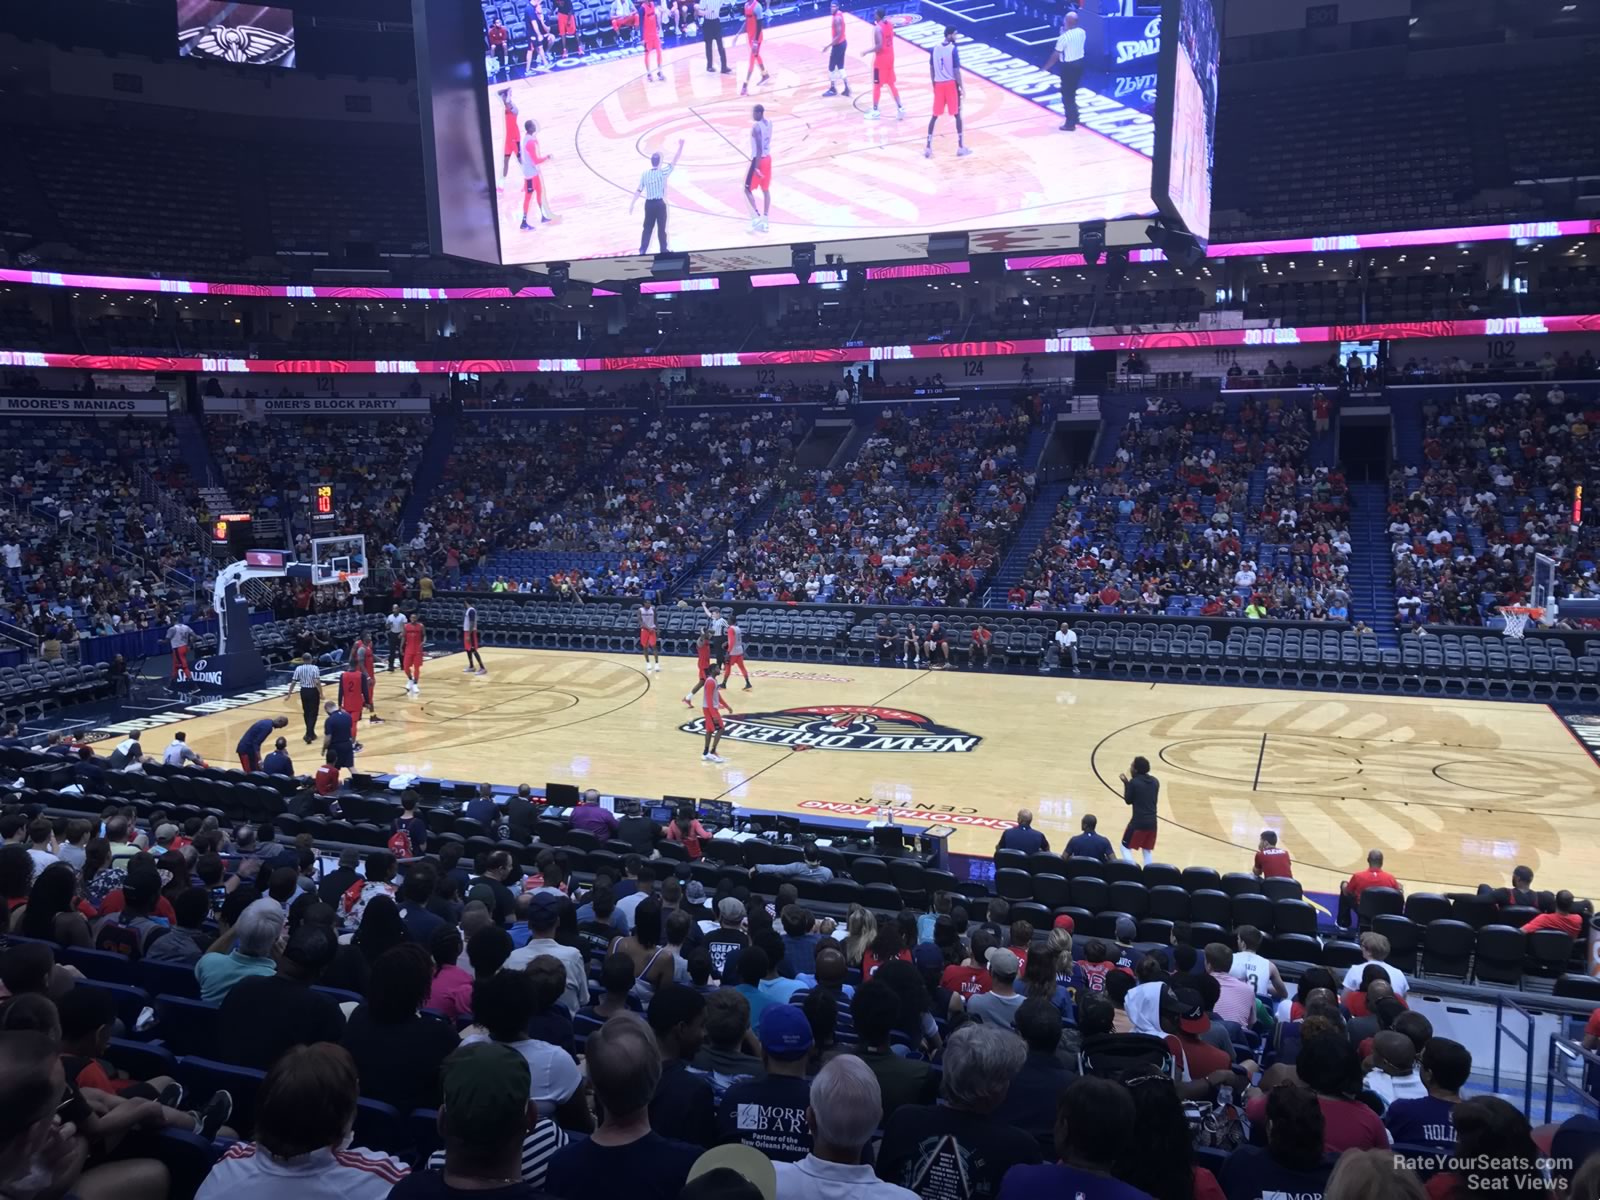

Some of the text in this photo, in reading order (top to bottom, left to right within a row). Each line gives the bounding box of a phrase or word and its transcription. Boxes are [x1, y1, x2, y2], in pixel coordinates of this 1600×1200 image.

[1510, 224, 1524, 238] DO
[963, 361, 984, 376] 124
[316, 377, 335, 391] 121
[564, 376, 584, 390] 122
[756, 370, 775, 384] 123
[8, 399, 136, 410] MOORE'S MANIACS
[265, 400, 397, 409] OMER'S BLOCK PARTY
[319, 496, 331, 512] 10
[861, 736, 979, 752] NEW
[801, 801, 871, 815] KING
[855, 797, 978, 814] CENTER
[1116, 957, 1133, 968] AVIS
[1054, 971, 1072, 983] AVIS
[961, 981, 982, 994] DAVIS
[759, 1105, 806, 1121] MORR
[741, 1138, 810, 1153] New Orleans Pelicans
[752, 1133, 777, 1142] Partner
[786, 1136, 799, 1144] the
